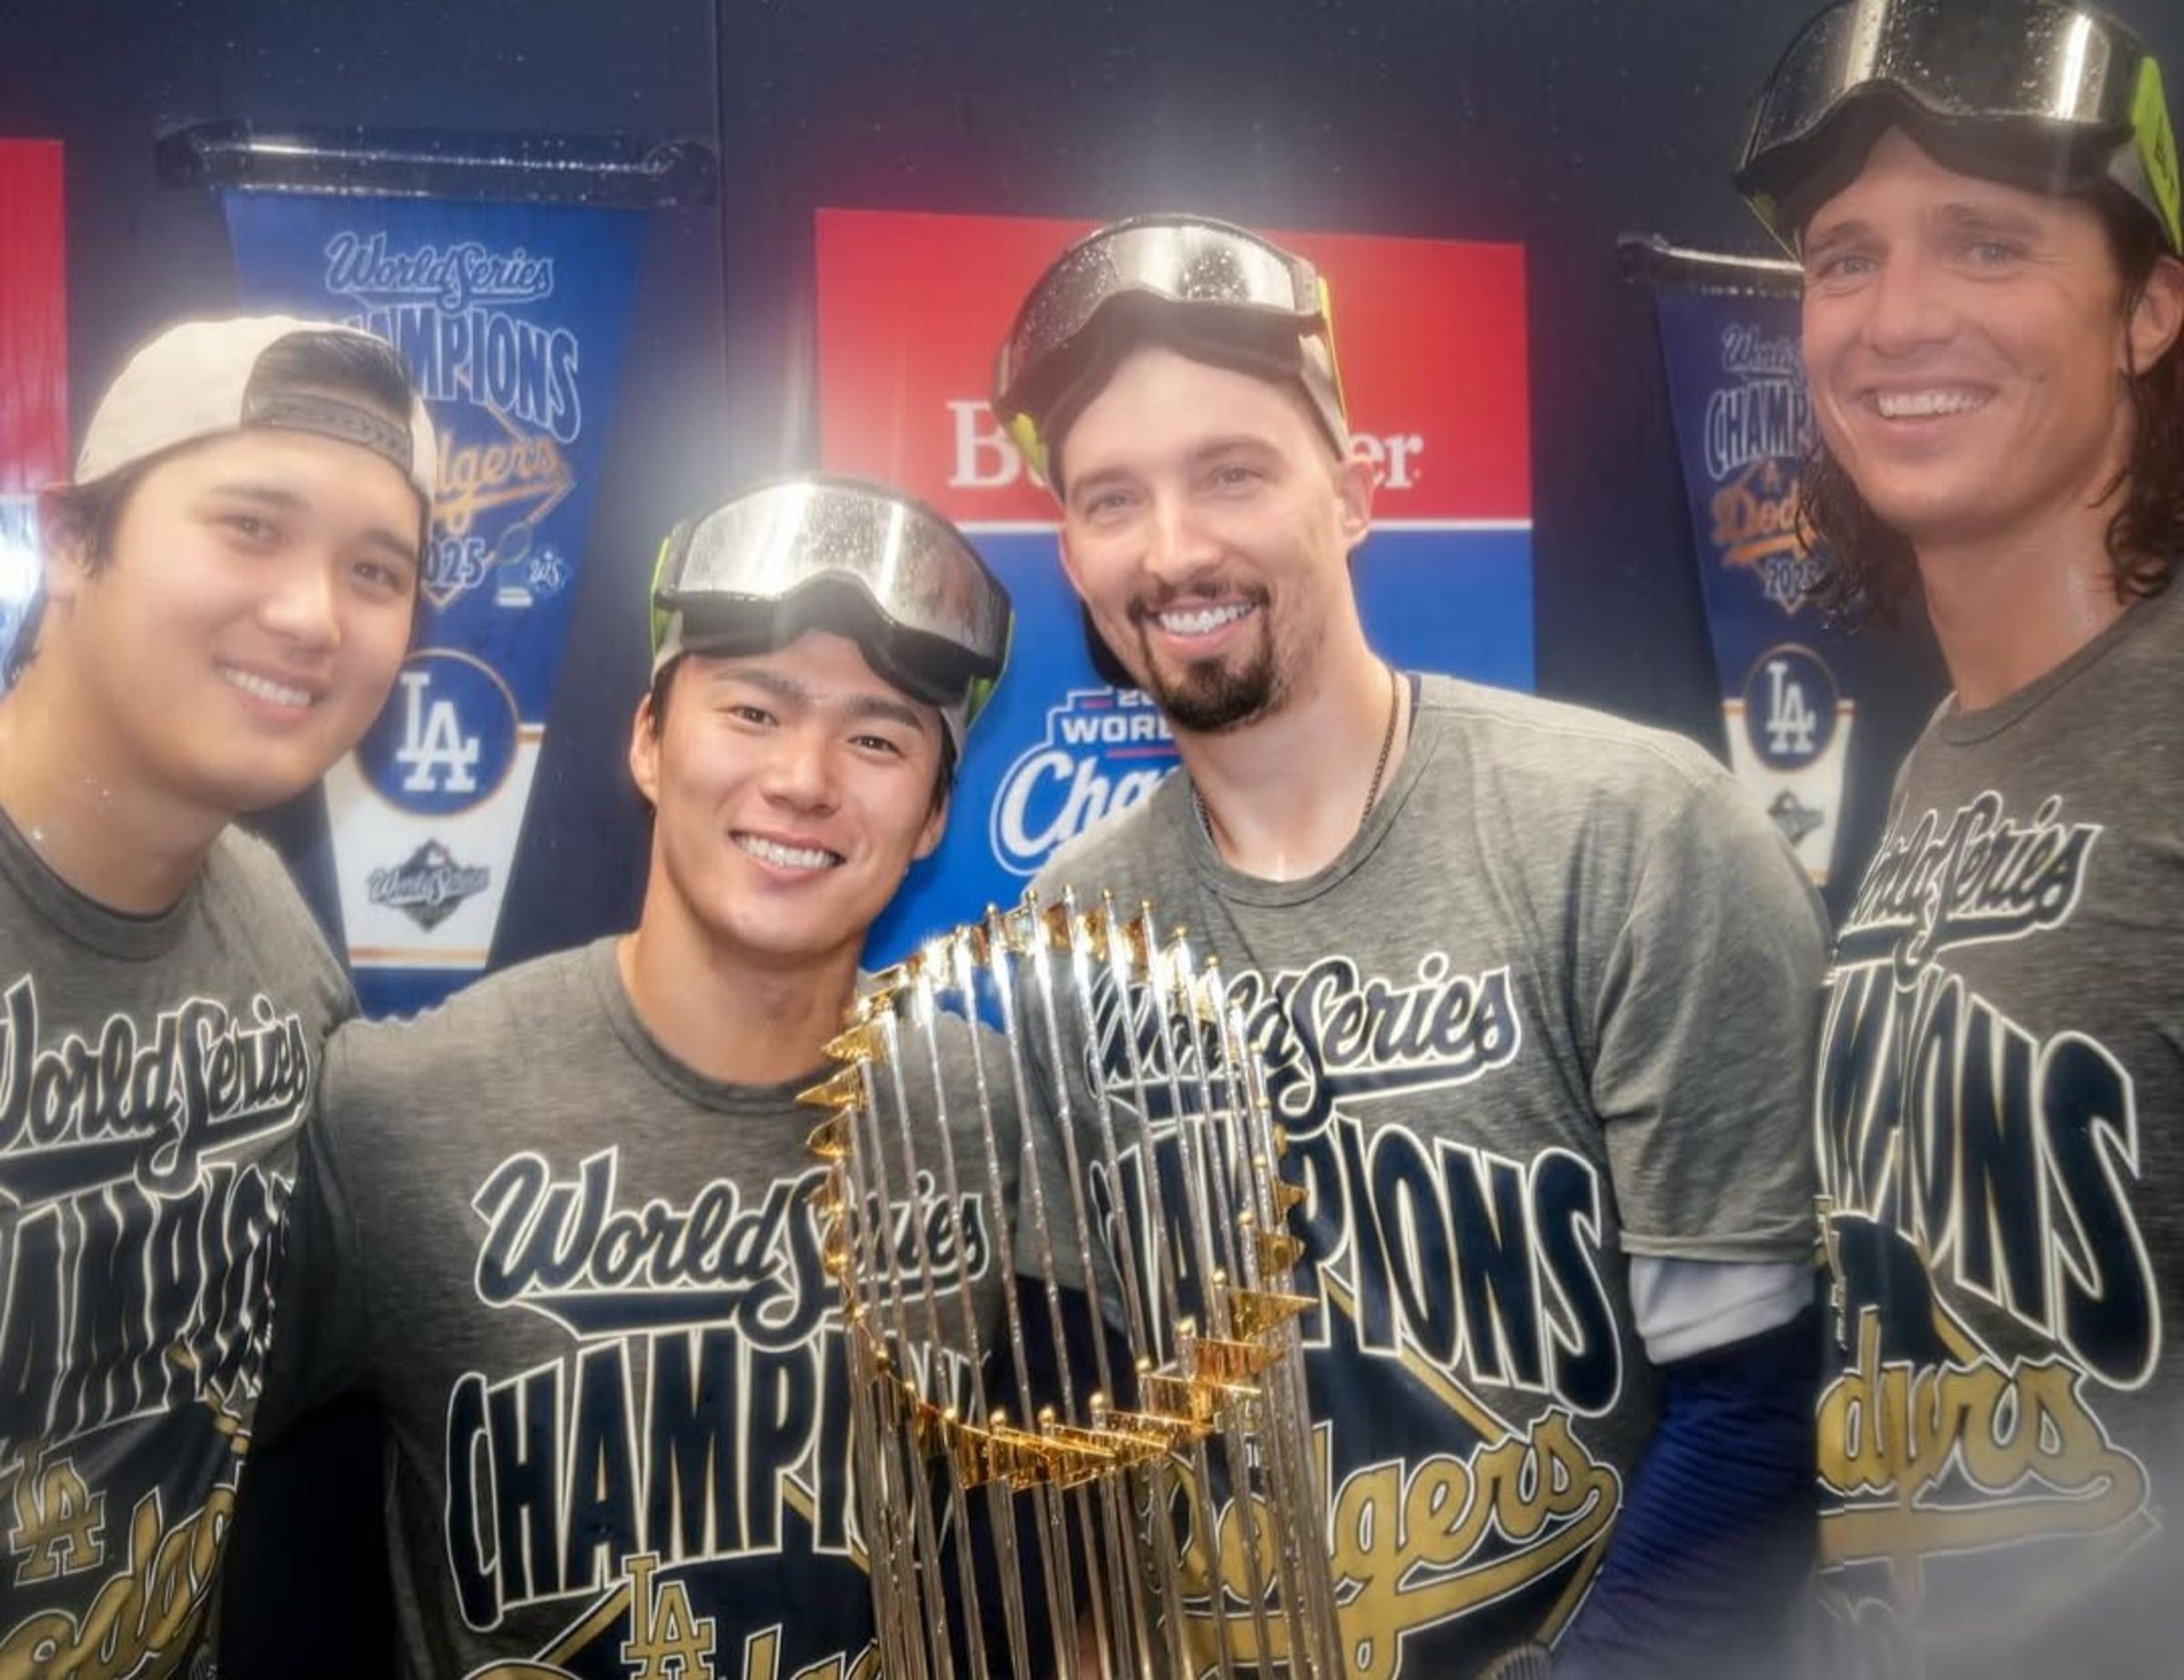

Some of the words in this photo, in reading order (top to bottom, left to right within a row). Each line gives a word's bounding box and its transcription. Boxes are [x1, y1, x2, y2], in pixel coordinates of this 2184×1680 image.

[397, 672, 480, 792] LA
[1061, 714, 1175, 744] WORL
[1766, 661, 1816, 754] LA
[1268, 951, 1522, 1139] Series
[471, 1145, 796, 1309] World
[622, 1551, 698, 1680] LA
